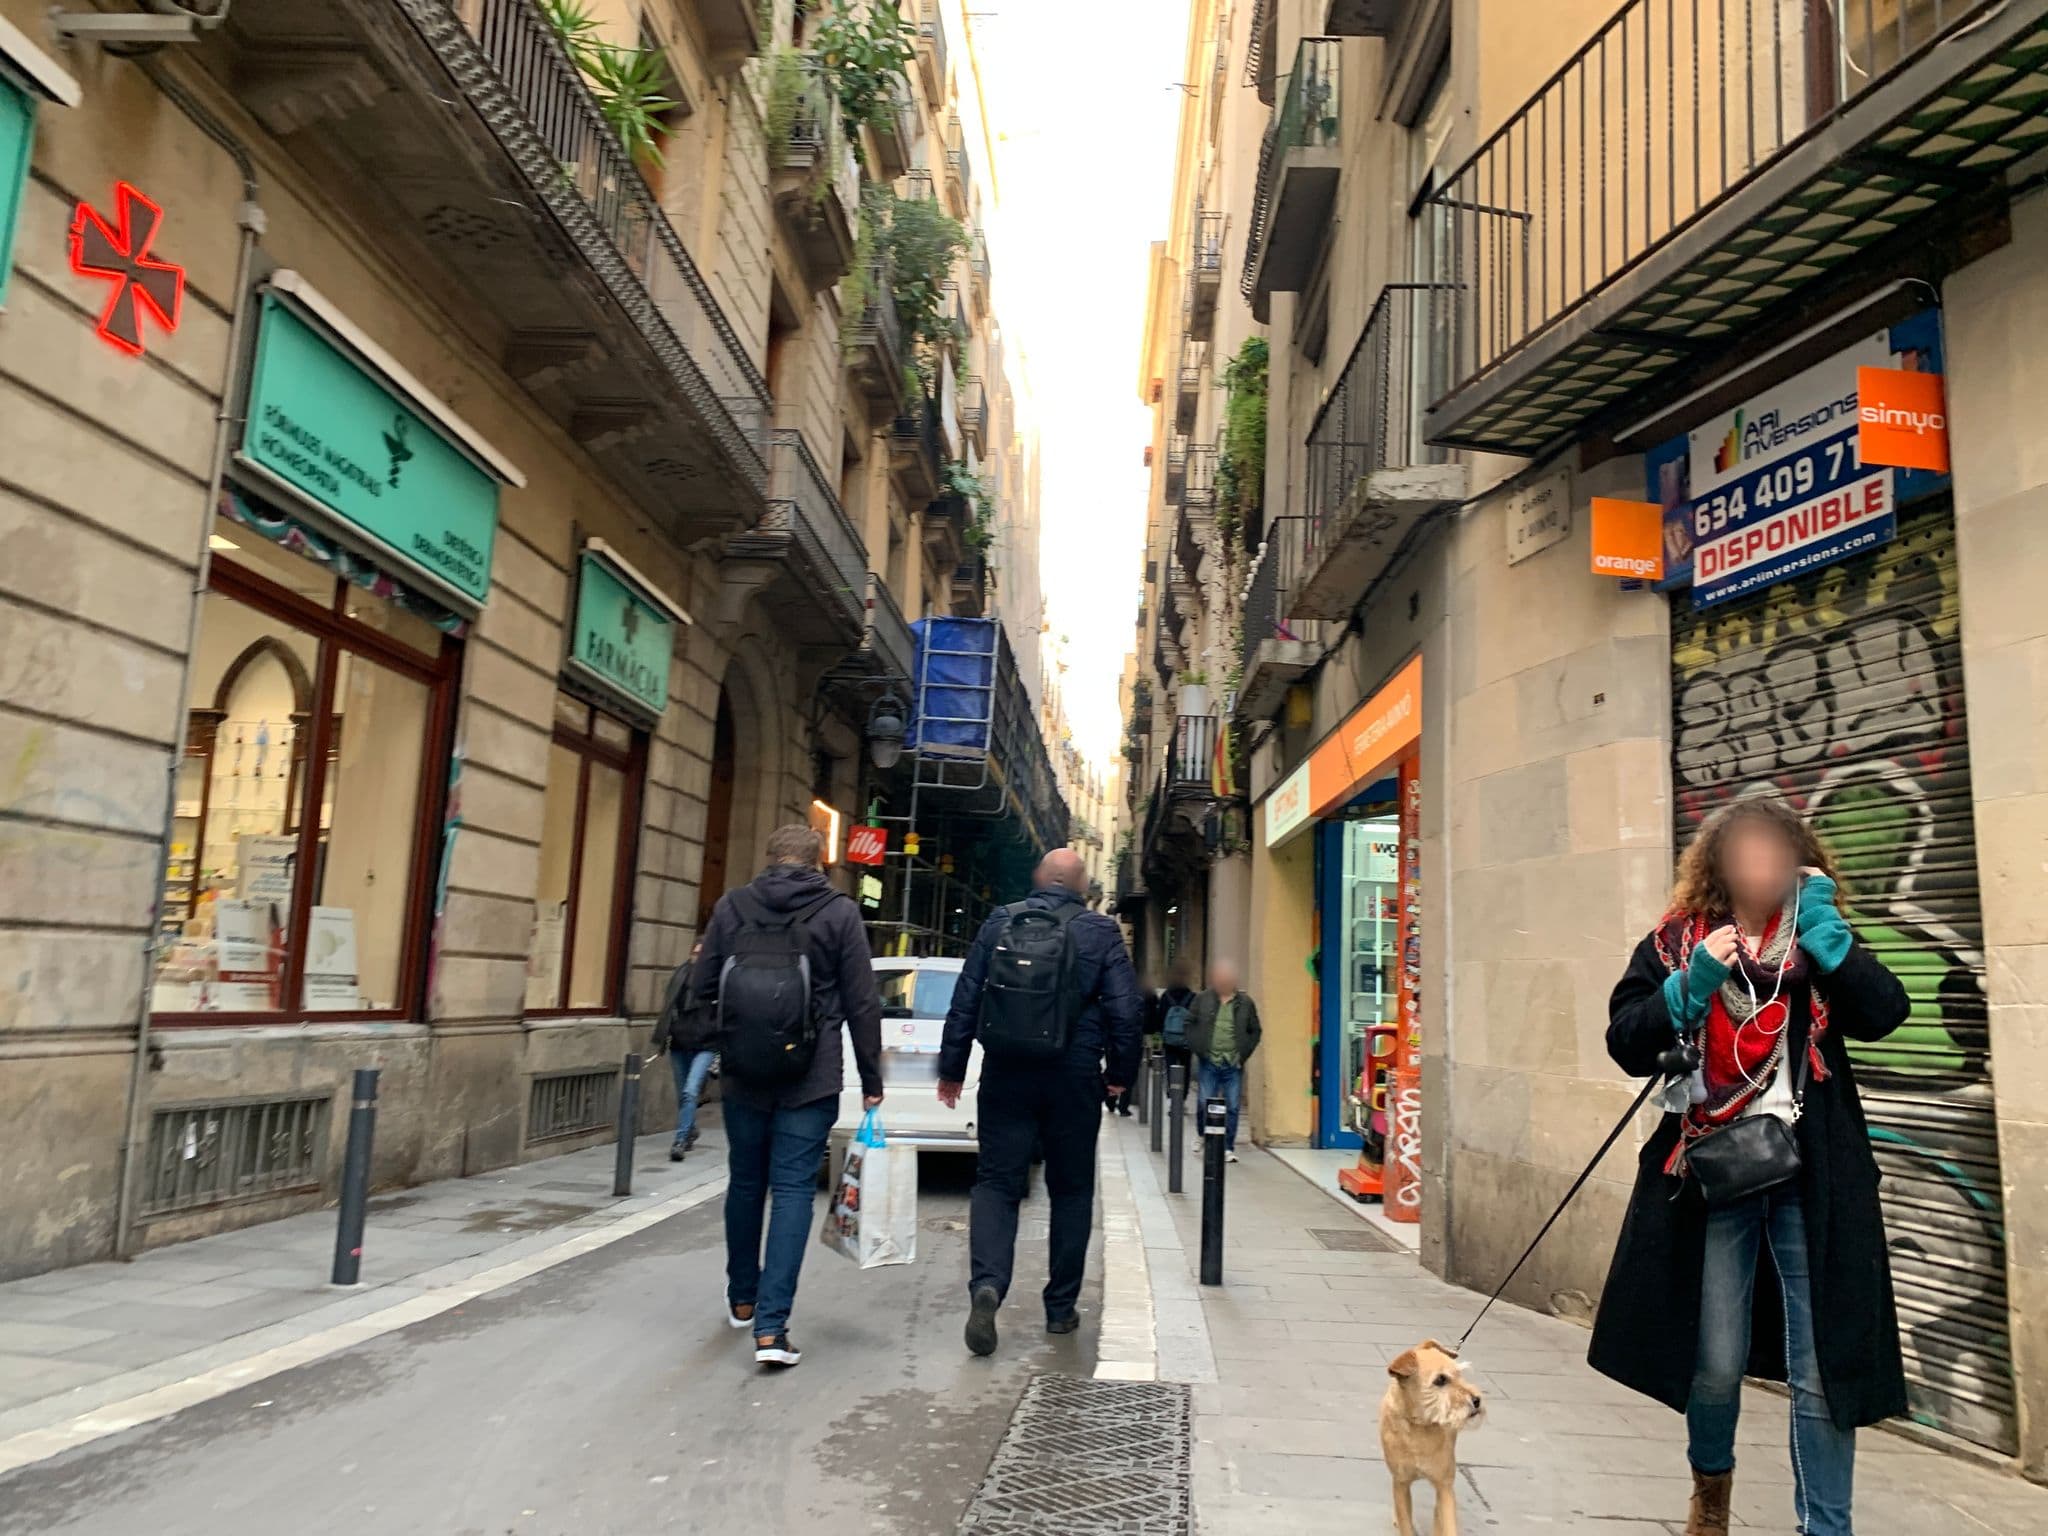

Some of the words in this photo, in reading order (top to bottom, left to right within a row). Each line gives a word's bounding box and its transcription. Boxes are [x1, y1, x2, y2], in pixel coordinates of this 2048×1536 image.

[1744, 409, 1780, 442] ARI
[1861, 401, 1946, 435] simyo
[1694, 486, 1747, 537] 634
[1754, 456, 1814, 509] 409
[1825, 433, 1862, 481] 71
[1701, 478, 1884, 579] DISPONIBLE
[1595, 555, 1656, 576] orange
[1704, 530, 1877, 602] www.ariinversions.com
[847, 830, 885, 861] illy
